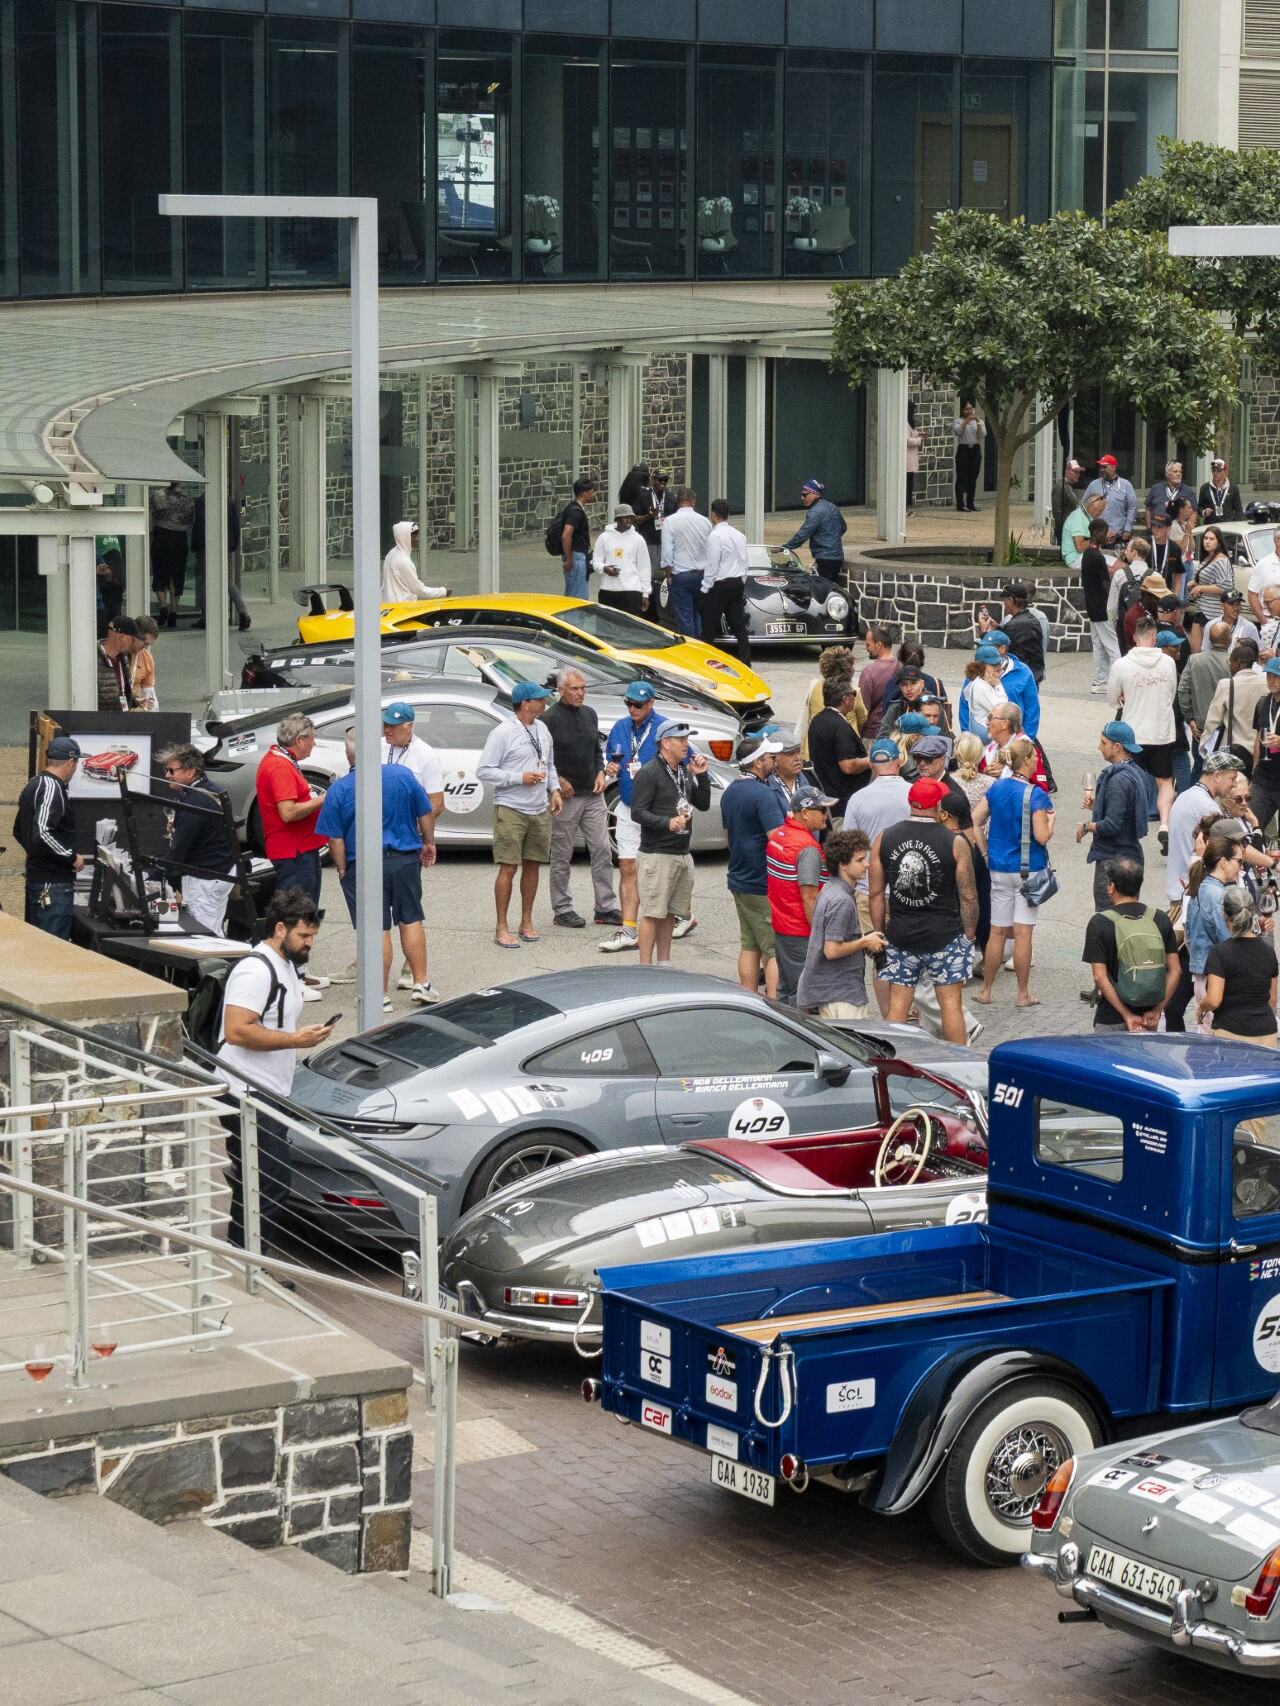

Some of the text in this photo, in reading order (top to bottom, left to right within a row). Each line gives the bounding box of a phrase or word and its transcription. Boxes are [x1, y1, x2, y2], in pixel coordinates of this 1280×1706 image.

[443, 783, 478, 795] 415
[889, 840, 941, 864] WE LIVE TO FIGHT
[892, 890, 938, 908] ANOTHER DAY
[580, 1047, 614, 1063] 409
[694, 1084, 727, 1093] BIANCA
[991, 1082, 1025, 1108] 501
[734, 1115, 785, 1135] 409
[643, 1406, 669, 1427] car
[717, 1460, 770, 1500] CAA 1933
[1137, 1481, 1176, 1496] car
[1090, 1549, 1116, 1578] CAA
